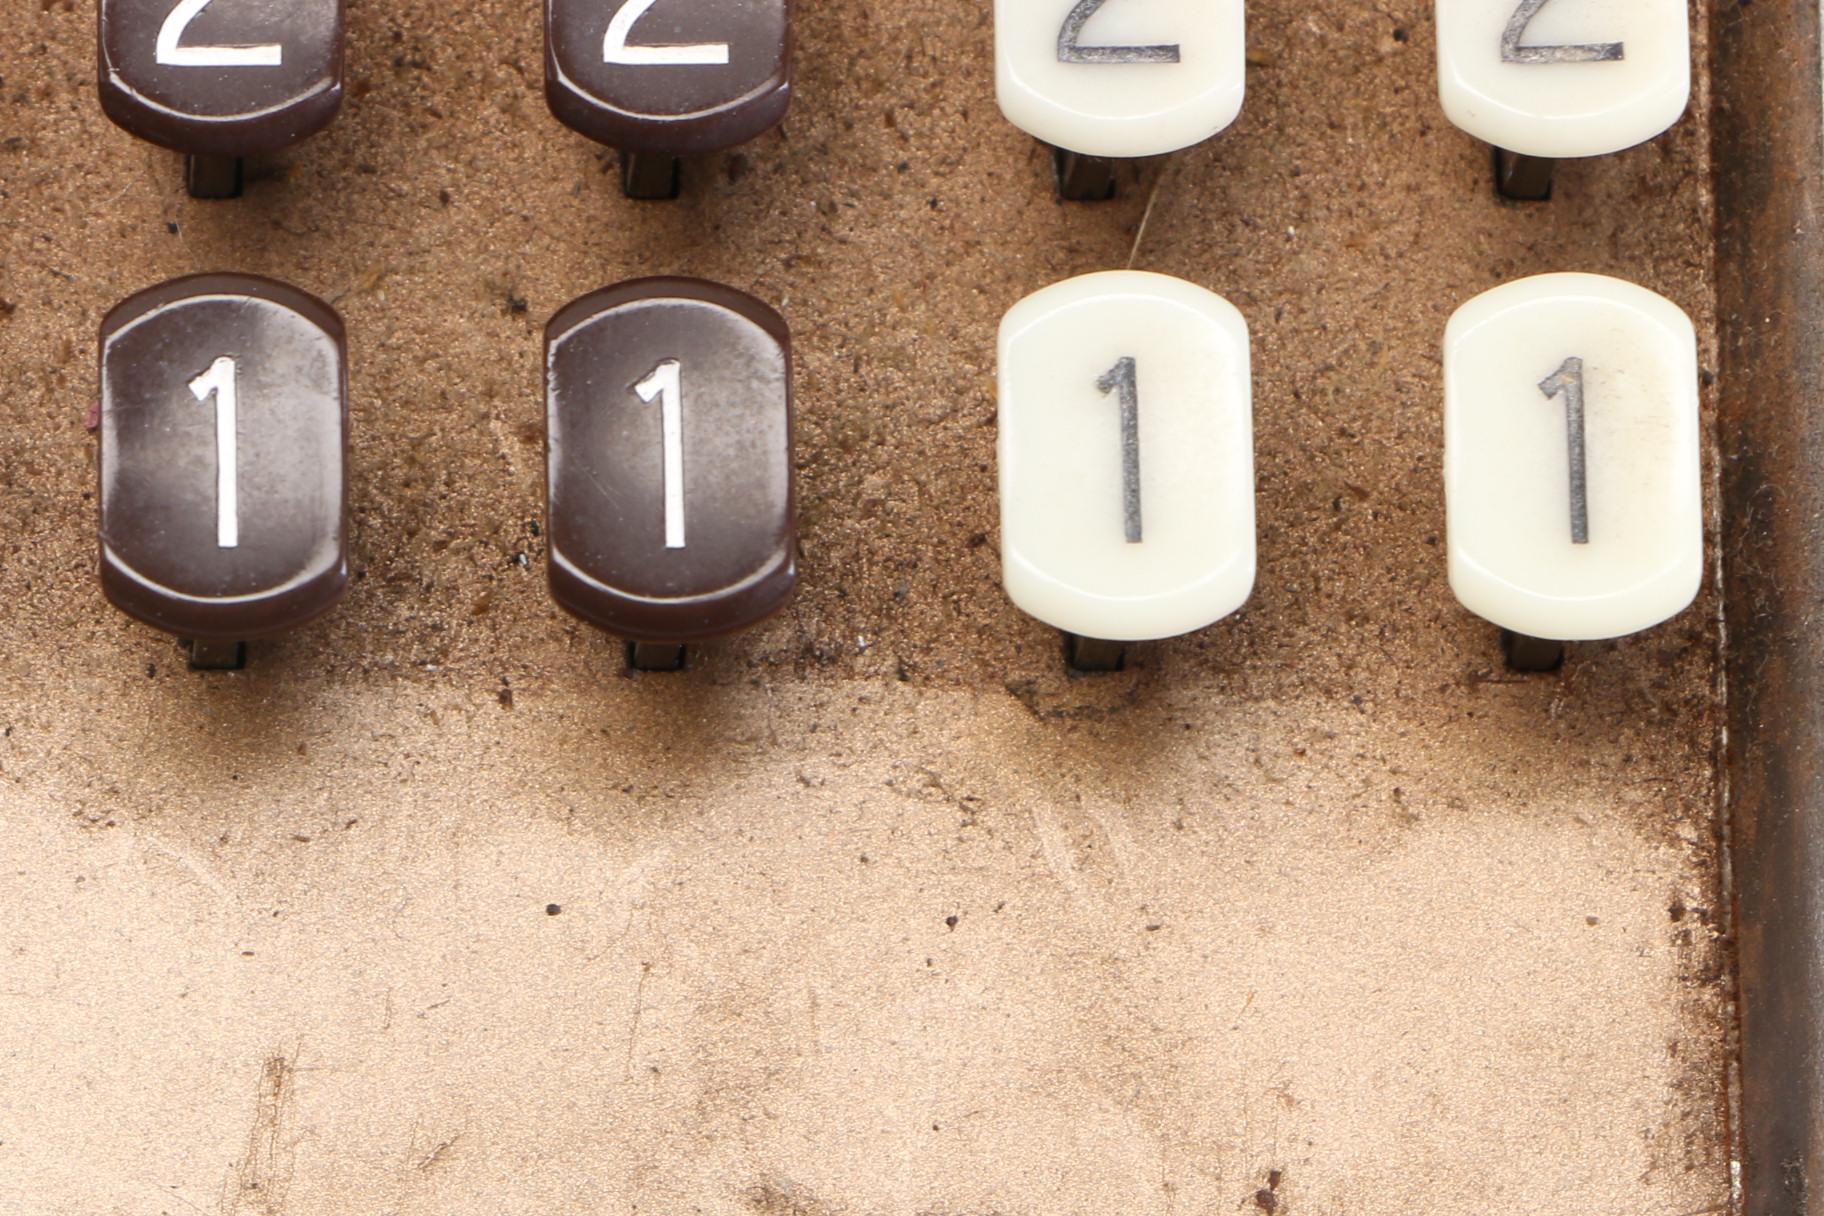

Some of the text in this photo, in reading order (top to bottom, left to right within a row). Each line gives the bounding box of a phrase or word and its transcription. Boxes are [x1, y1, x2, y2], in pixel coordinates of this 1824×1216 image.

[187, 355, 238, 548] 1
[634, 358, 686, 549] 1
[1095, 356, 1143, 543] 1
[1538, 356, 1589, 544] 1
